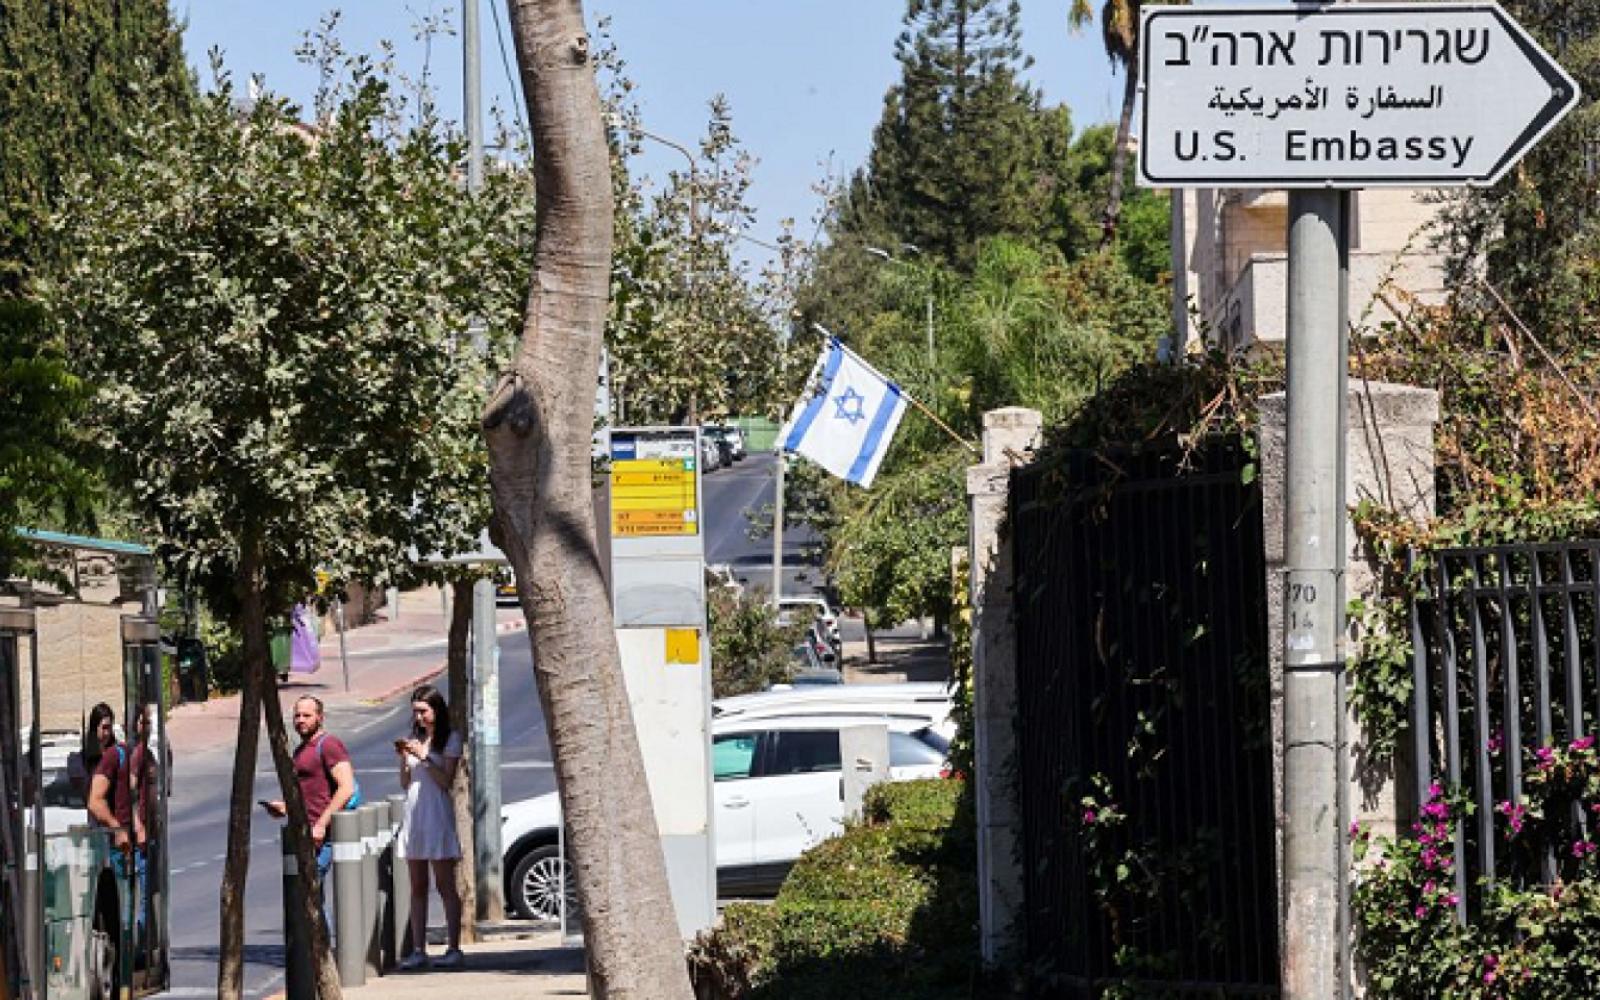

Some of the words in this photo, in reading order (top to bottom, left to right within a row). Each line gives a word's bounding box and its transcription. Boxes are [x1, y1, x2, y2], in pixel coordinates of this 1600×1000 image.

[1318, 28, 1490, 66] שגרירות
[1207, 76, 1328, 120] الأمريكية
[1345, 84, 1443, 119] السفارة
[1174, 130, 1247, 162] U.S.
[1285, 129, 1475, 168] Embassy
